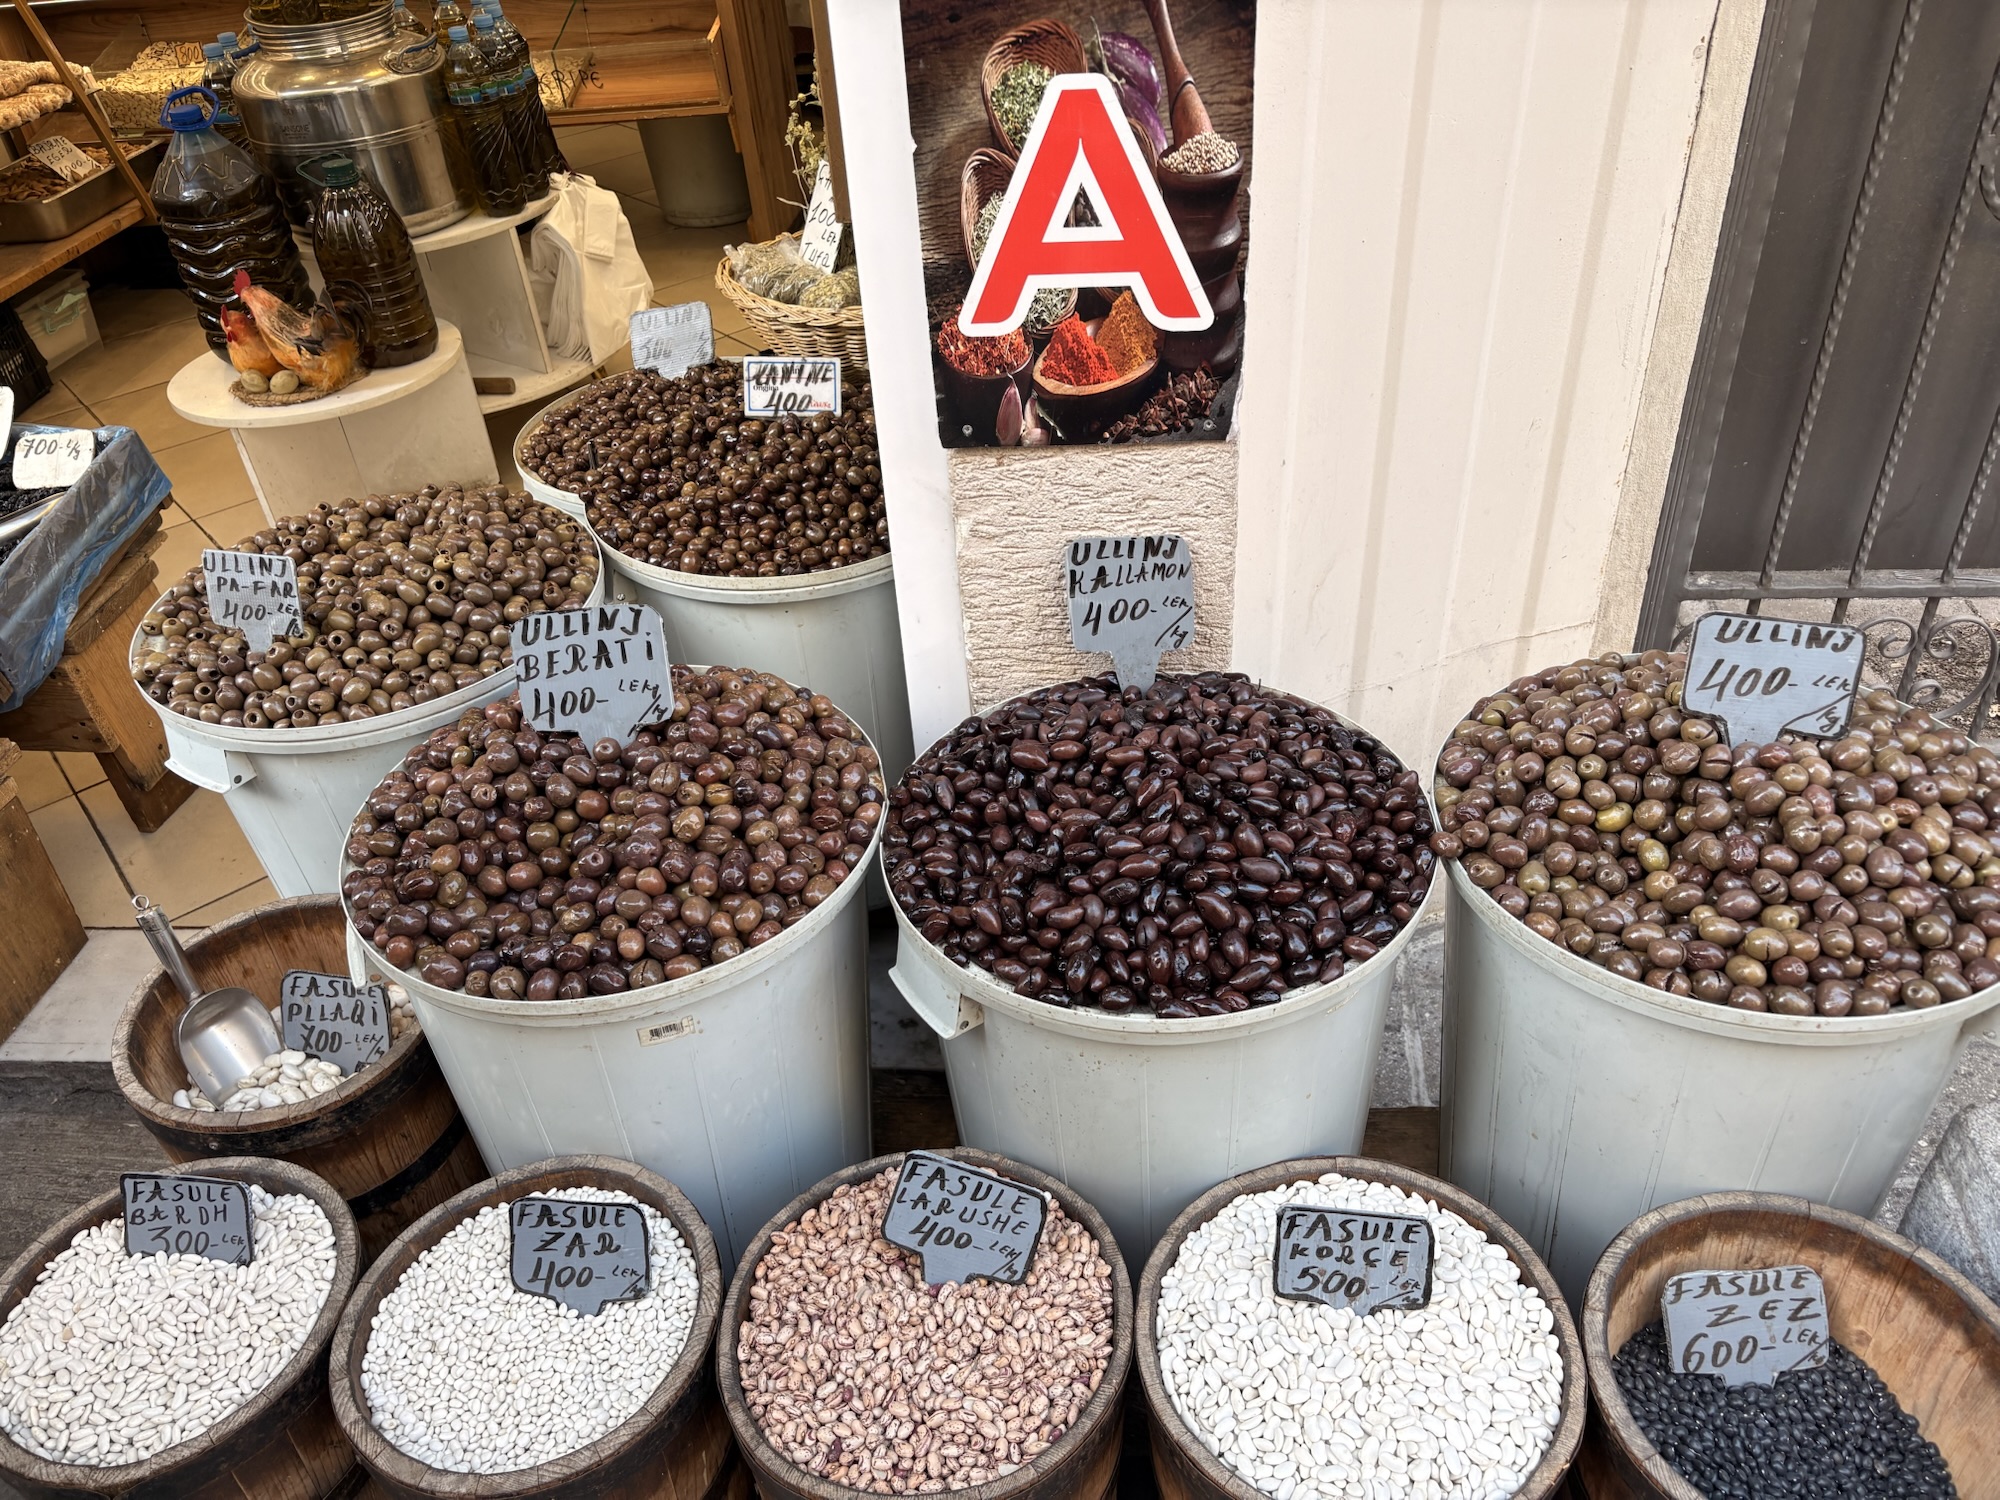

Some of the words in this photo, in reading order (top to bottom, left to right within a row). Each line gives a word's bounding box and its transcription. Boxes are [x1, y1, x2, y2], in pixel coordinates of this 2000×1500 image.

[180, 46, 200, 63] 800
[966, 83, 1206, 329] A
[763, 391, 813, 416] 400
[203, 551, 287, 577] ULLINJ
[1071, 535, 1181, 566] ULLINJ
[216, 576, 297, 598] PA-FAR
[521, 607, 643, 647] ULLINJ
[1714, 617, 1857, 653] ULLINJ
[1811, 674, 1852, 692] LEK
[131, 1180, 233, 1203] FASULE
[903, 1161, 1030, 1215] FASULE
[129, 1203, 228, 1226] BARDH
[517, 1203, 626, 1228] FASULE
[1282, 1213, 1423, 1244] FASULE
[533, 1231, 622, 1258] ZAR
[1666, 1268, 1813, 1305] FASULE
[1706, 1297, 1822, 1328] ZEZ
